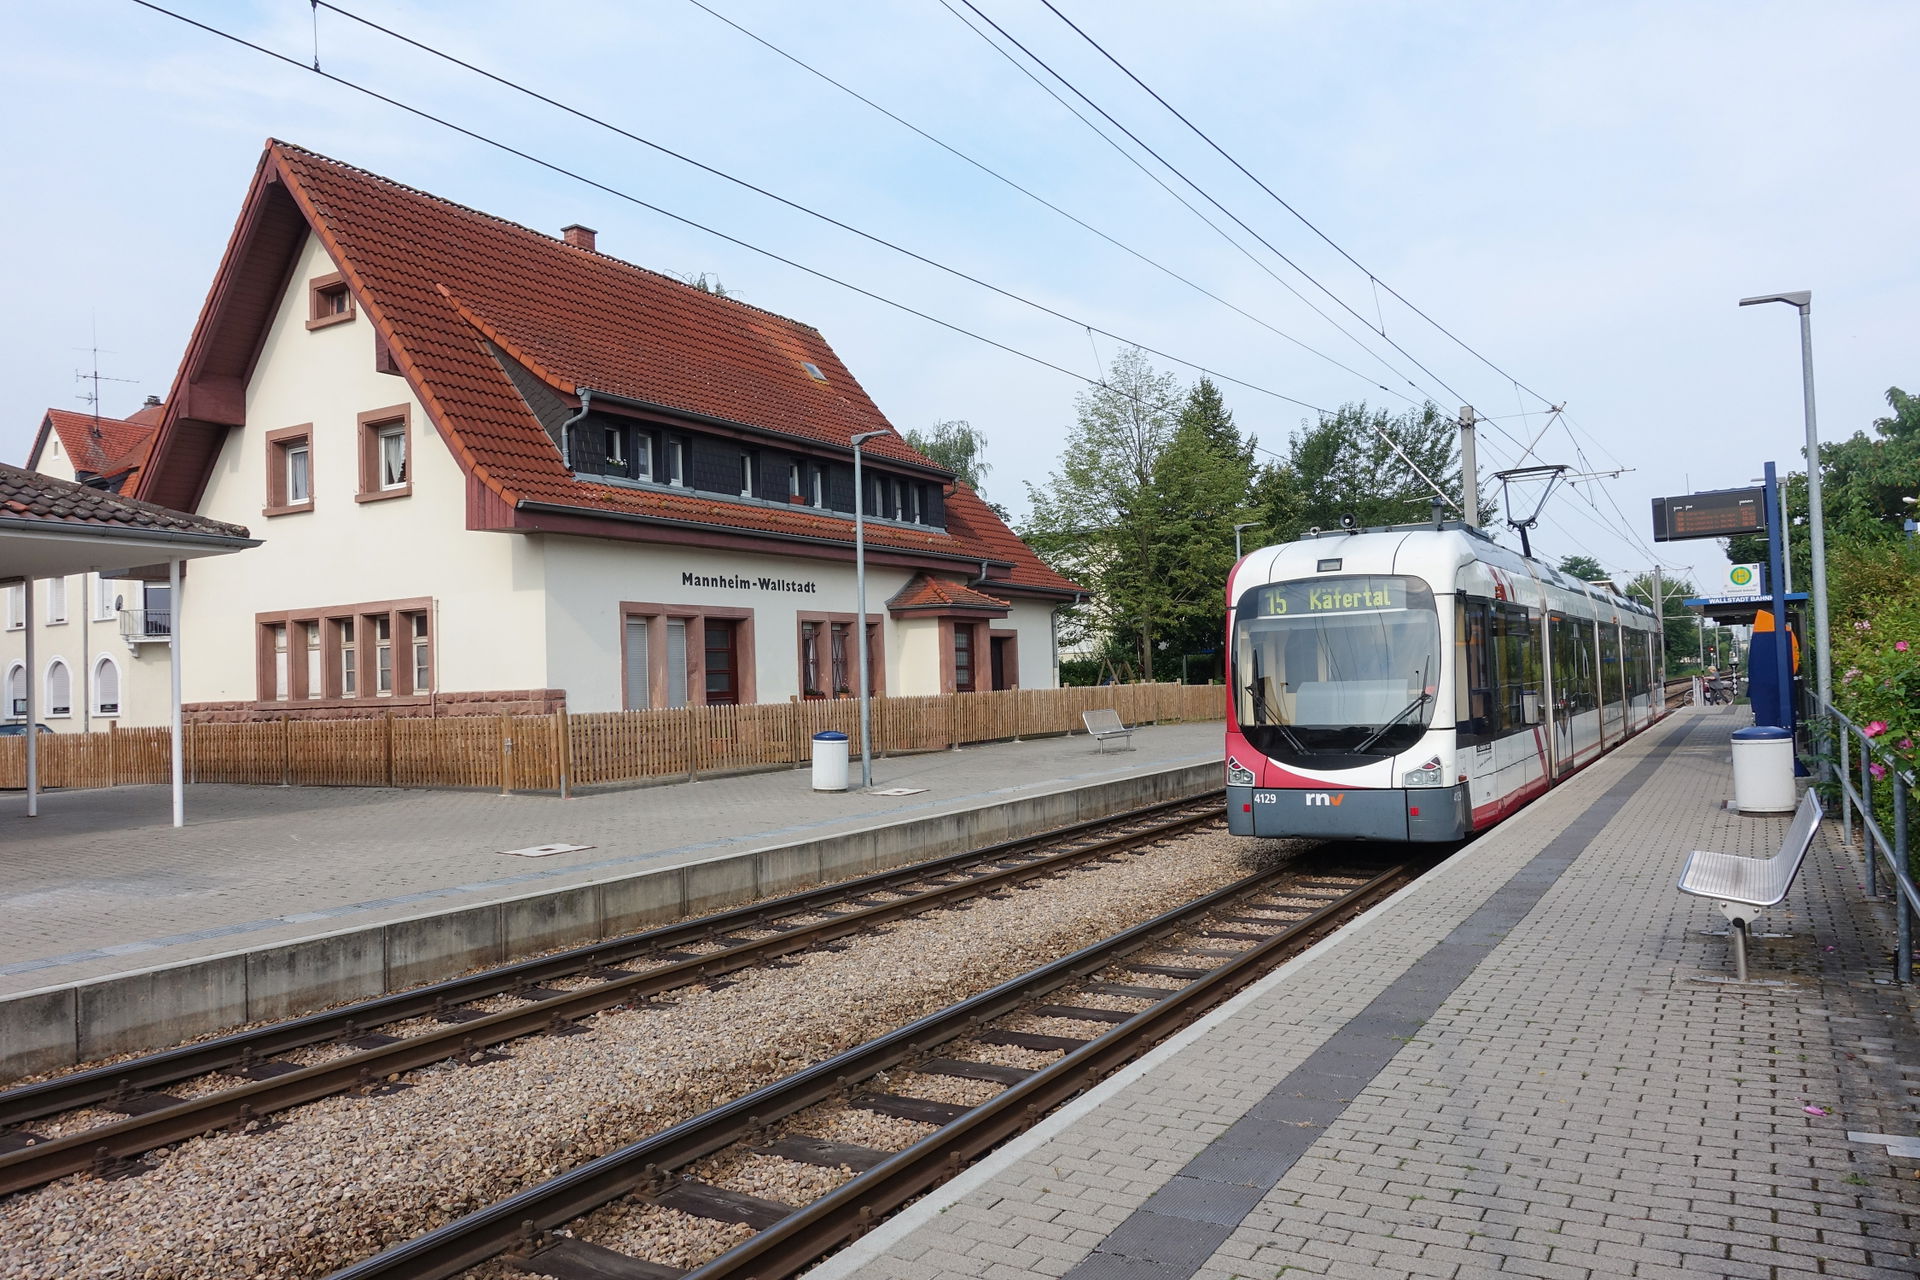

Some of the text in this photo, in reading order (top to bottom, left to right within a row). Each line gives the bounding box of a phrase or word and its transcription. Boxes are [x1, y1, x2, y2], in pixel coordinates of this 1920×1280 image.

[682, 571, 816, 594] Mannheim-Wallstadt
[1265, 584, 1391, 615] 15 Käfertal
[1708, 595, 1749, 604] WALLSTADT
[1254, 793, 1277, 804] 4129
[1305, 792, 1345, 807] rnv
